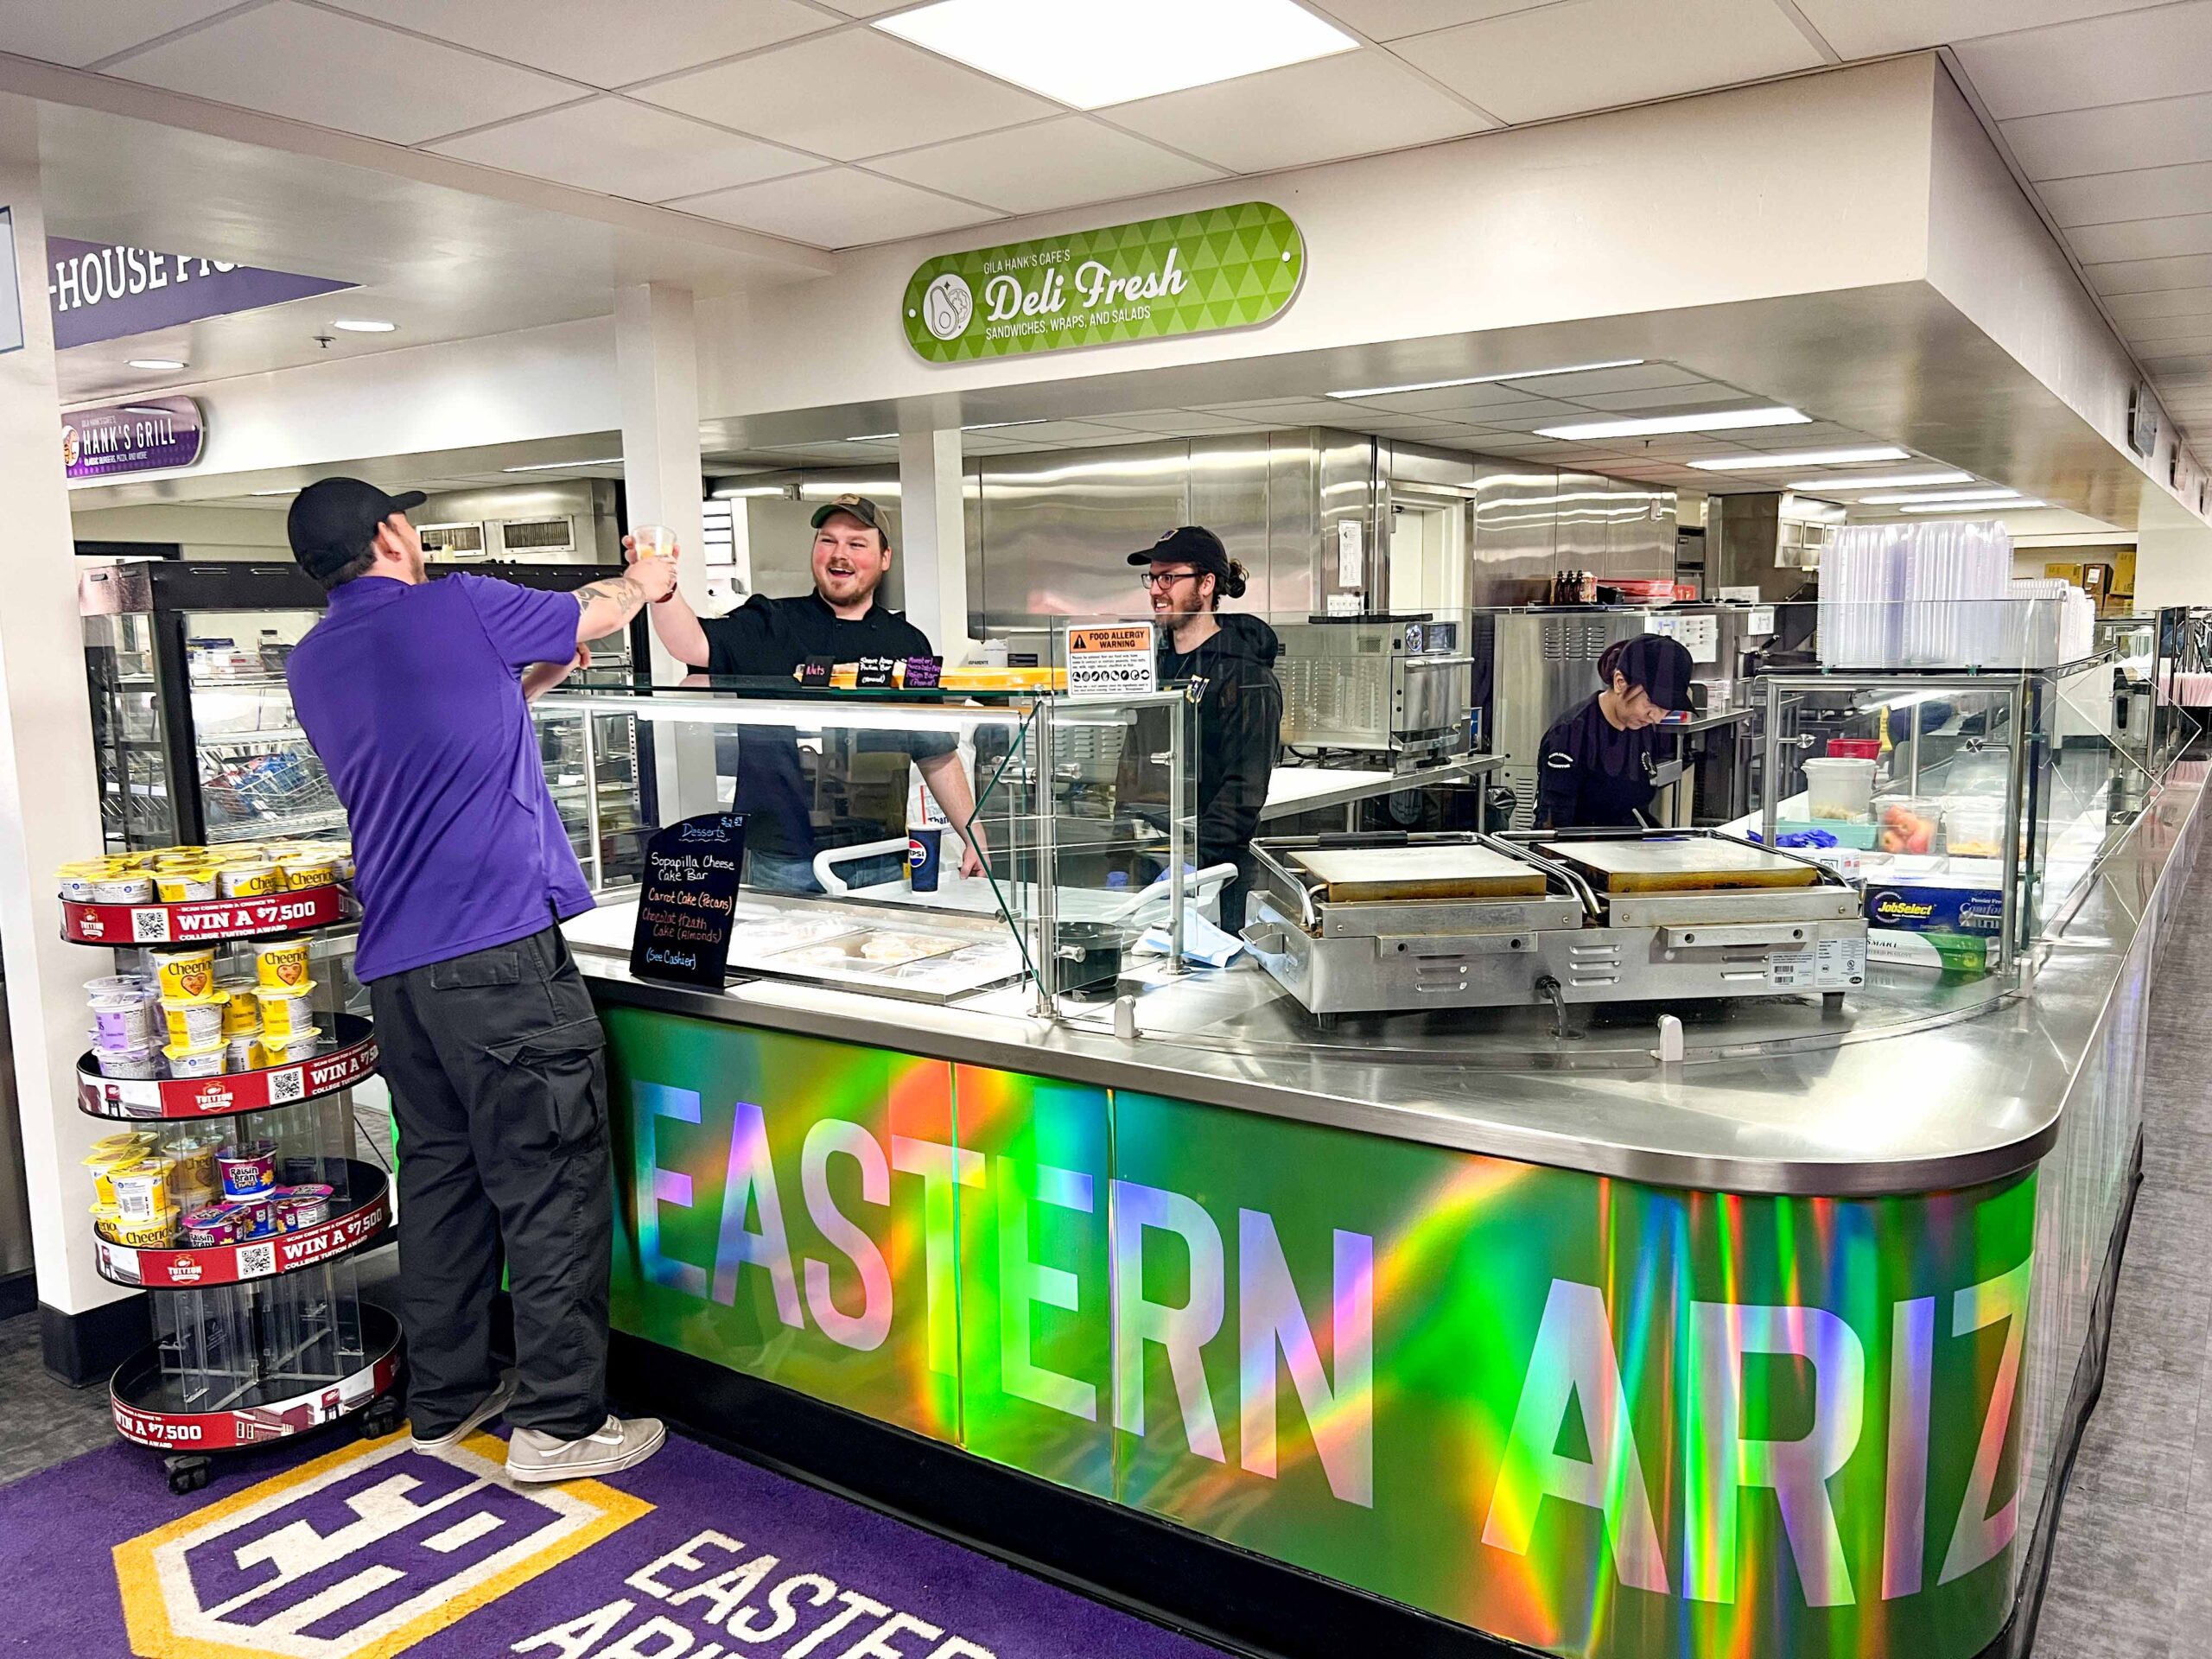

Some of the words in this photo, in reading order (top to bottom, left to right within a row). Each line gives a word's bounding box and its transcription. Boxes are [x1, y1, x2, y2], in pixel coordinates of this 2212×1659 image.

[983, 260, 1003, 275] GILA
[1005, 254, 1038, 270] HANK'S
[1039, 249, 1071, 266] CAFE'S
[985, 268, 1066, 322] Deli
[1075, 247, 1188, 308] Fresh
[986, 321, 1048, 340] SANDWICHES,
[1051, 315, 1087, 332] WRAPS,
[1090, 312, 1109, 327] AND
[1112, 306, 1151, 323] SALADS
[83, 423, 131, 454] HANK'S
[137, 418, 176, 448] GRILL
[1111, 631, 1145, 639] ALLERGY
[1099, 640, 1135, 649] WARNING
[805, 664, 825, 676] Nuts
[682, 823, 726, 838] Desserts
[652, 852, 700, 872] Sopapilla
[703, 855, 735, 871] Cheese
[658, 869, 683, 882] Cake
[684, 868, 709, 881] Bar
[648, 887, 676, 904] Carrot
[677, 891, 696, 906] Cake
[698, 892, 733, 916] (Pecans)
[1878, 901, 1933, 915] JobSelect
[177, 912, 230, 931] WIN
[235, 911, 254, 926] A
[257, 900, 315, 923] $7,500
[179, 933, 219, 942] COLLEGE
[220, 928, 255, 938] TUITION
[256, 925, 288, 935] AWARD
[653, 924, 675, 938] Cake
[677, 928, 722, 944] (Almonds)
[265, 950, 309, 965] Cheerios
[646, 947, 663, 963] (See
[664, 950, 696, 970] Cashier)
[168, 960, 213, 976] Cheerios
[311, 1064, 346, 1085] WIN
[349, 1058, 360, 1073] A
[195, 1092, 233, 1104] TUITION
[313, 1082, 341, 1096] COLLEGE
[231, 1166, 259, 1178] Raisin
[235, 1174, 256, 1183] Bran
[282, 1235, 328, 1260] WIN
[332, 1230, 346, 1245] A
[347, 1208, 383, 1236] $7,500
[284, 1255, 320, 1270] COLLEGE
[321, 1246, 347, 1259] TUITION
[347, 1235, 368, 1249] AWARD
[168, 1266, 202, 1274] TUITION
[632, 1080, 1373, 1509] EASTERN
[114, 1408, 134, 1432] WIN
[136, 1421, 147, 1436] A
[149, 1422, 202, 1440] $7,500
[1481, 1249, 2034, 1607] ARIZ
[149, 1440, 173, 1449] AWARD
